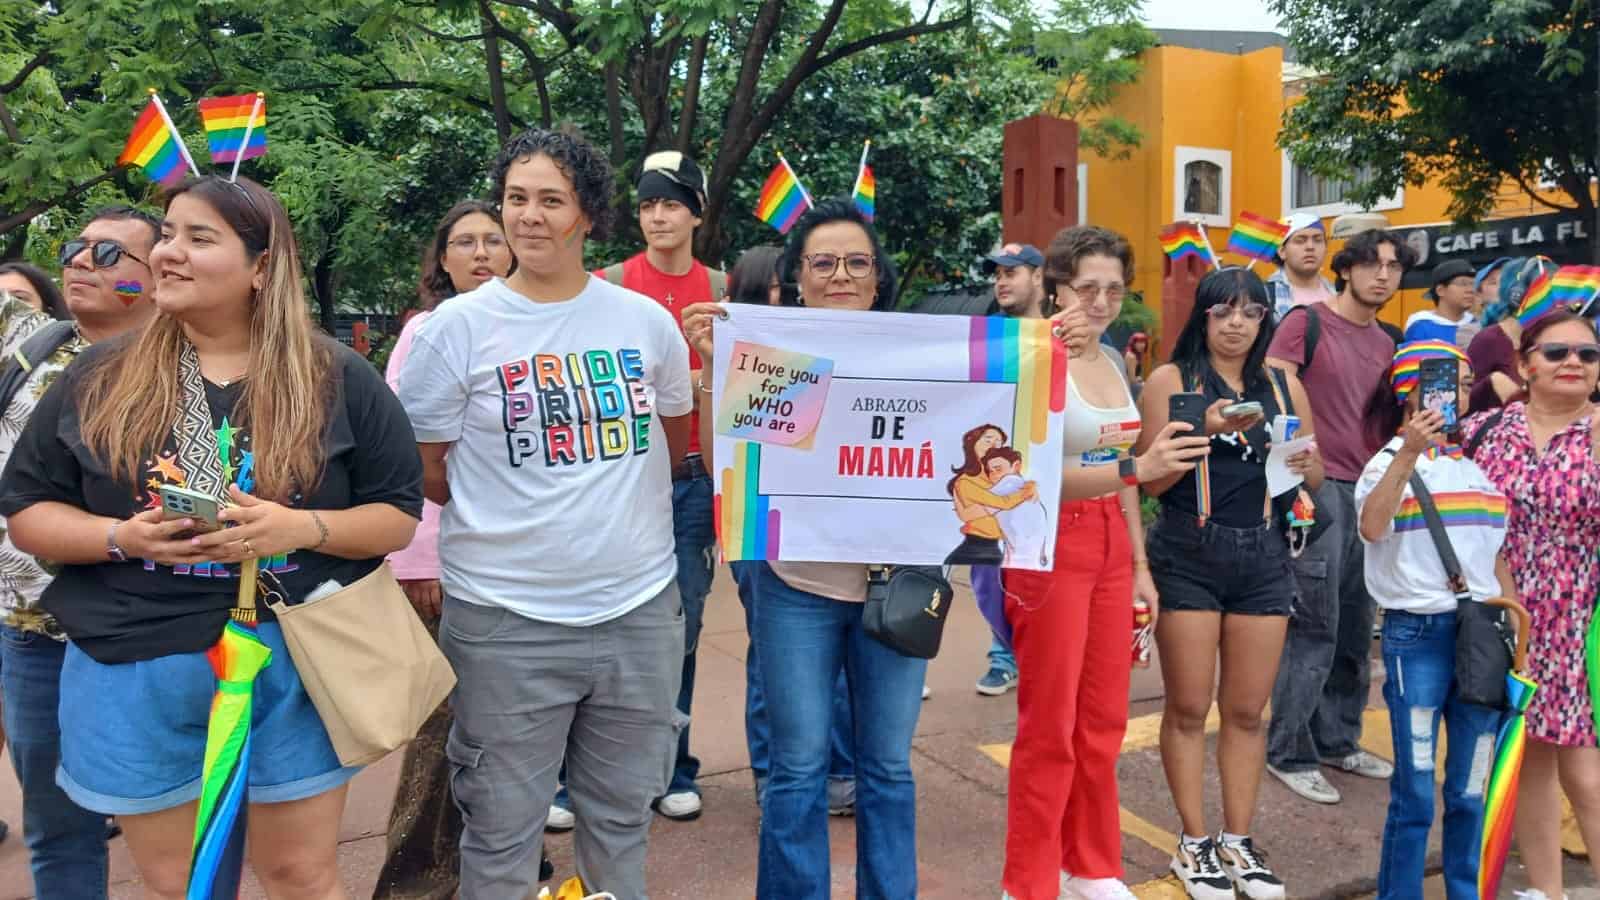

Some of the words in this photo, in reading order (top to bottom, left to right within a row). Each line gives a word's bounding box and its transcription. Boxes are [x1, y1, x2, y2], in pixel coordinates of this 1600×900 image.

[1435, 231, 1499, 253] CAFE
[1511, 225, 1544, 245] LA
[496, 348, 644, 392] PRIDE
[737, 353, 749, 371] I
[752, 356, 785, 378] love
[788, 369, 820, 385] you
[761, 378, 788, 395] for
[503, 382, 657, 432] PRIDE
[748, 393, 794, 417] WHO
[851, 397, 928, 414] ABRAZOS
[732, 412, 763, 429] you
[768, 418, 796, 433] are
[871, 415, 905, 441] DE
[506, 415, 651, 467] PRIDE
[837, 441, 935, 479] MAMÁ
